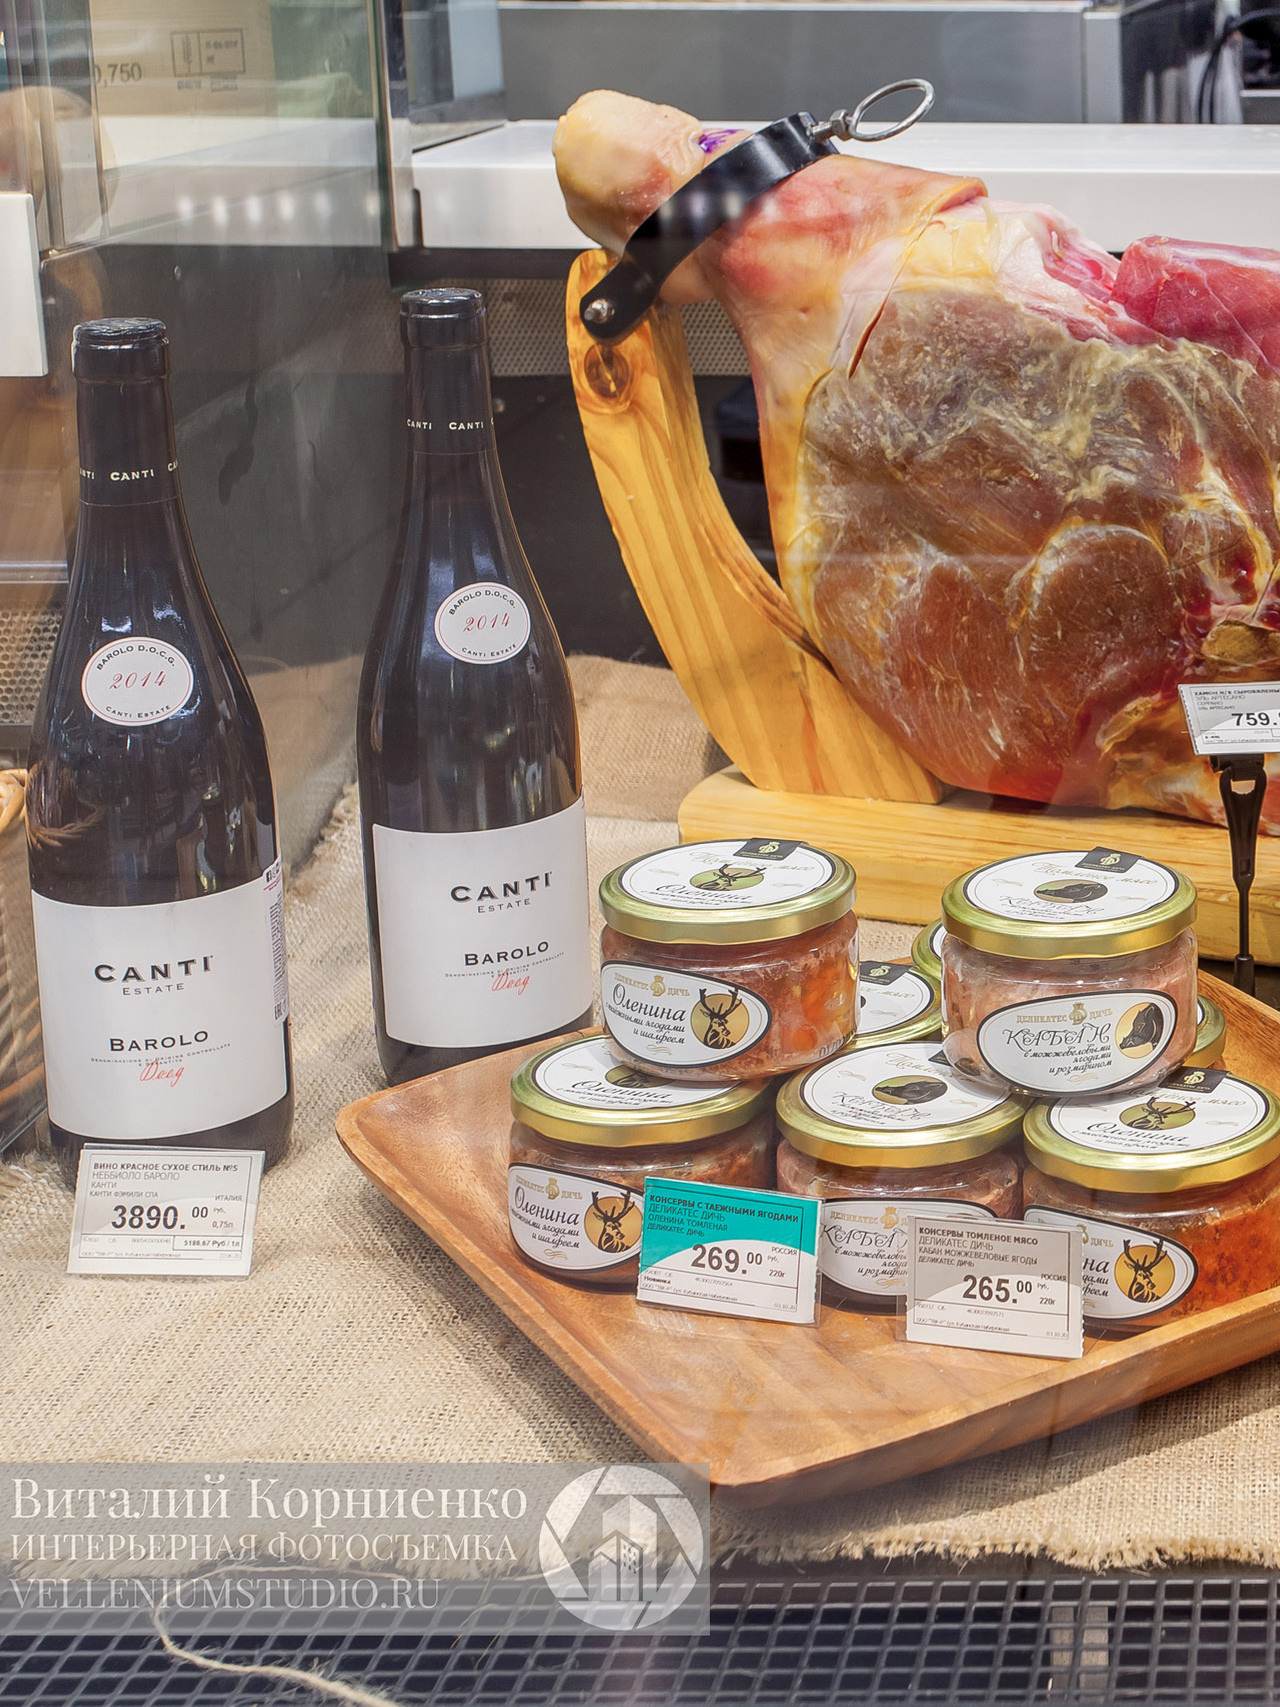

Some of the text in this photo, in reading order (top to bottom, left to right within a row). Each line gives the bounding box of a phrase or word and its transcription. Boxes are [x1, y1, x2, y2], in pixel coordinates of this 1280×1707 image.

[407, 419, 484, 430] CANTI CANTI
[110, 469, 154, 481] CANTI
[448, 591, 482, 616] BAROLO
[463, 613, 509, 632] 2014
[96, 645, 134, 671] BAROLO
[462, 643, 516, 657] CANTI ESTATE
[109, 670, 167, 690] 2014
[105, 704, 171, 719] CANTI ESTATE
[451, 872, 551, 902] CANTI
[478, 898, 530, 914] ESTATE
[464, 941, 549, 966] BAROLO
[94, 956, 212, 983] CANTI
[122, 983, 184, 996] ESTATE
[613, 983, 686, 1021] Оленина
[110, 1031, 209, 1052] BAROLO
[1002, 1023, 1111, 1053] КАБАН
[92, 1171, 179, 1180] НЕББИОЛО БАРОЛО
[93, 1162, 118, 1170] ВИНО
[121, 1163, 160, 1171] КРАСНОЕ
[515, 1186, 580, 1225] Оленина
[649, 1203, 725, 1222] ДЕЛИКАТЕС ДИЧЬ
[650, 1194, 799, 1223] КОНСЕРВЫ С ТАЕЖНЫМИ ЯГОДАМИ
[647, 1224, 704, 1237] ДЕЛИКАТЕС ДИЧЬ
[648, 1214, 727, 1231] ОЛЕНИНА ТОМЛЕНАЯ
[919, 1227, 1038, 1245] КОНСЕРВЫ ТОМЛЕНОЕ МЯСО
[919, 1236, 994, 1250] ДЕЛИКАТЕС ДИЧЬ
[771, 1246, 798, 1256] РОССИЯ
[919, 1247, 1037, 1265] КАБАН МОЖЖЕВЕЛОВЫЕ ЯГОДЫ
[918, 1256, 974, 1268] ДЕЛИКАТЕС ДИЧЬ
[1040, 1273, 1067, 1282] РОССИЯ
